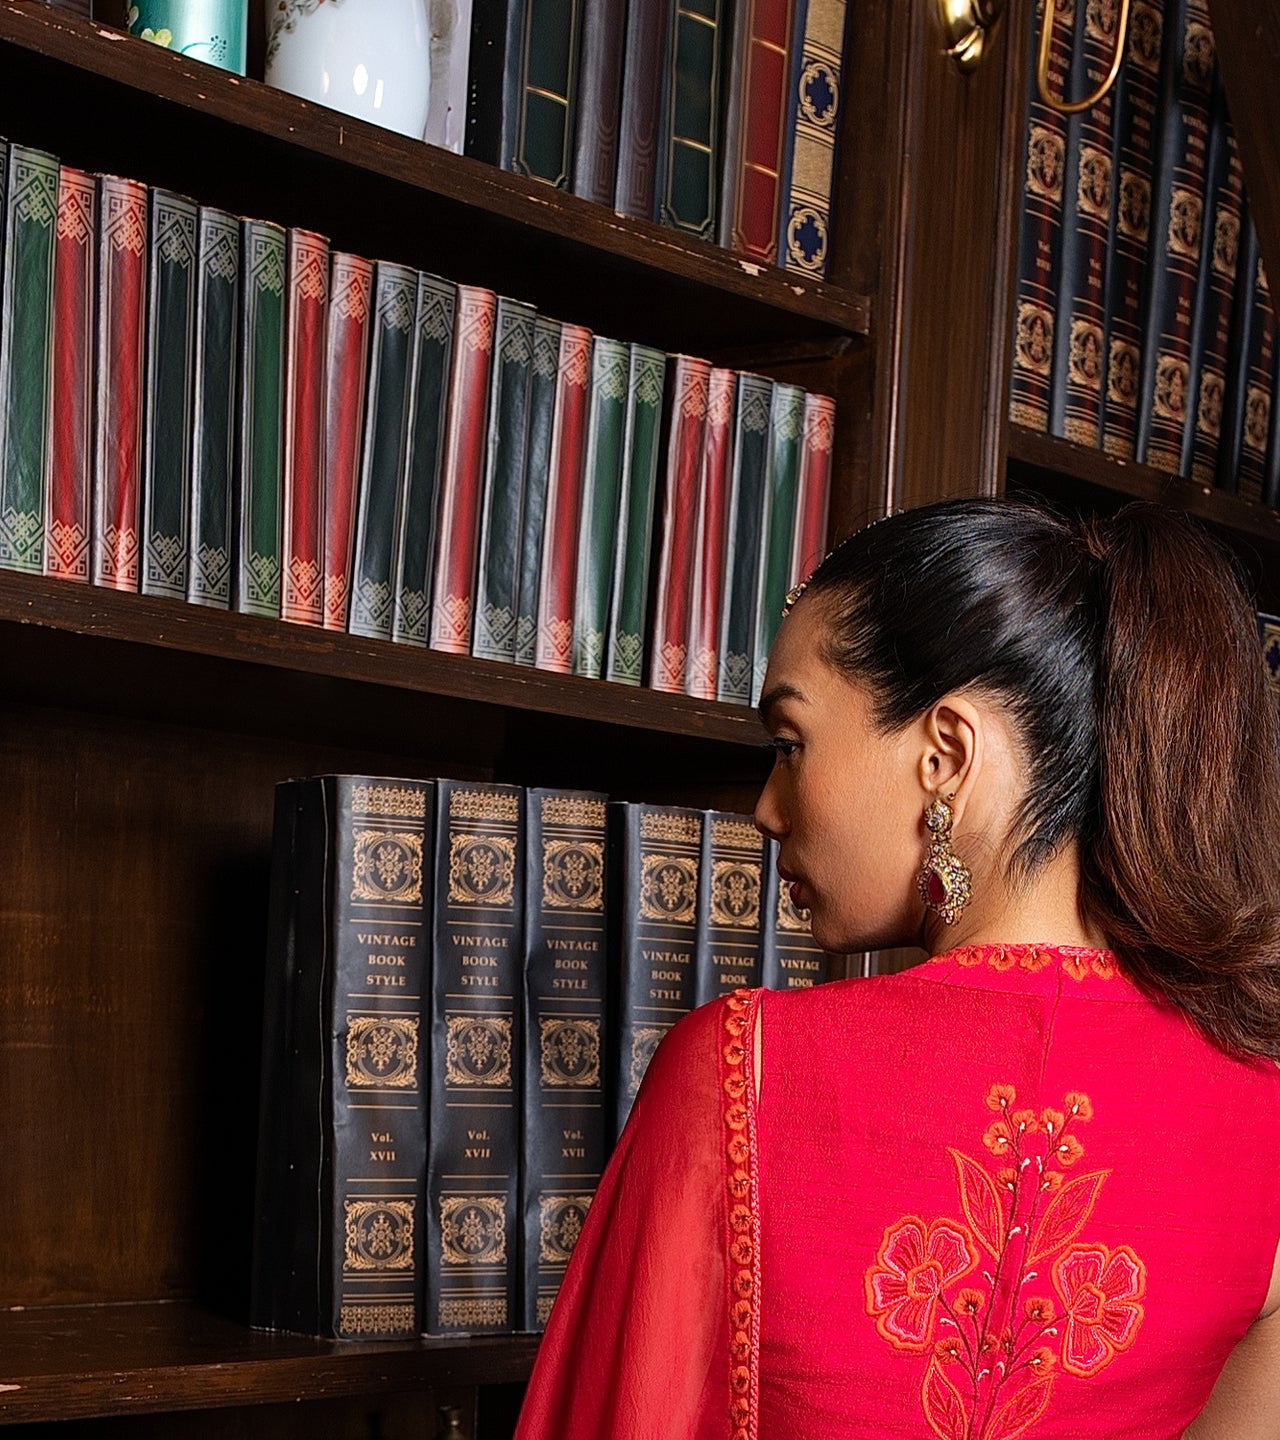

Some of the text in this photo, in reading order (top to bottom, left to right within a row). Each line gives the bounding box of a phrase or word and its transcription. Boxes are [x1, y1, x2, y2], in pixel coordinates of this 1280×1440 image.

[357, 933, 416, 946] VINTAGE
[452, 935, 507, 947] VINTAGE
[546, 939, 598, 951] VINTAGE
[368, 954, 405, 966] BOOK
[462, 955, 498, 967] BOOK
[641, 950, 689, 963] VINTAGE
[712, 955, 754, 967] VINTAGE
[554, 959, 588, 970] BOOK
[780, 958, 819, 970] VINTAGE
[366, 974, 406, 986] STYLE
[461, 975, 498, 987] STYLE
[651, 970, 681, 981] BOOK
[720, 974, 746, 984] BOOK
[553, 978, 587, 990] STYLE
[788, 977, 813, 988] BOOK
[649, 988, 680, 1000] STYLE
[371, 1132, 393, 1143] Vol.
[467, 1130, 490, 1141] Vol.
[563, 1130, 584, 1140] Vol.
[370, 1151, 395, 1161] XVII
[464, 1148, 490, 1158] XVII
[562, 1148, 585, 1158] XVII
